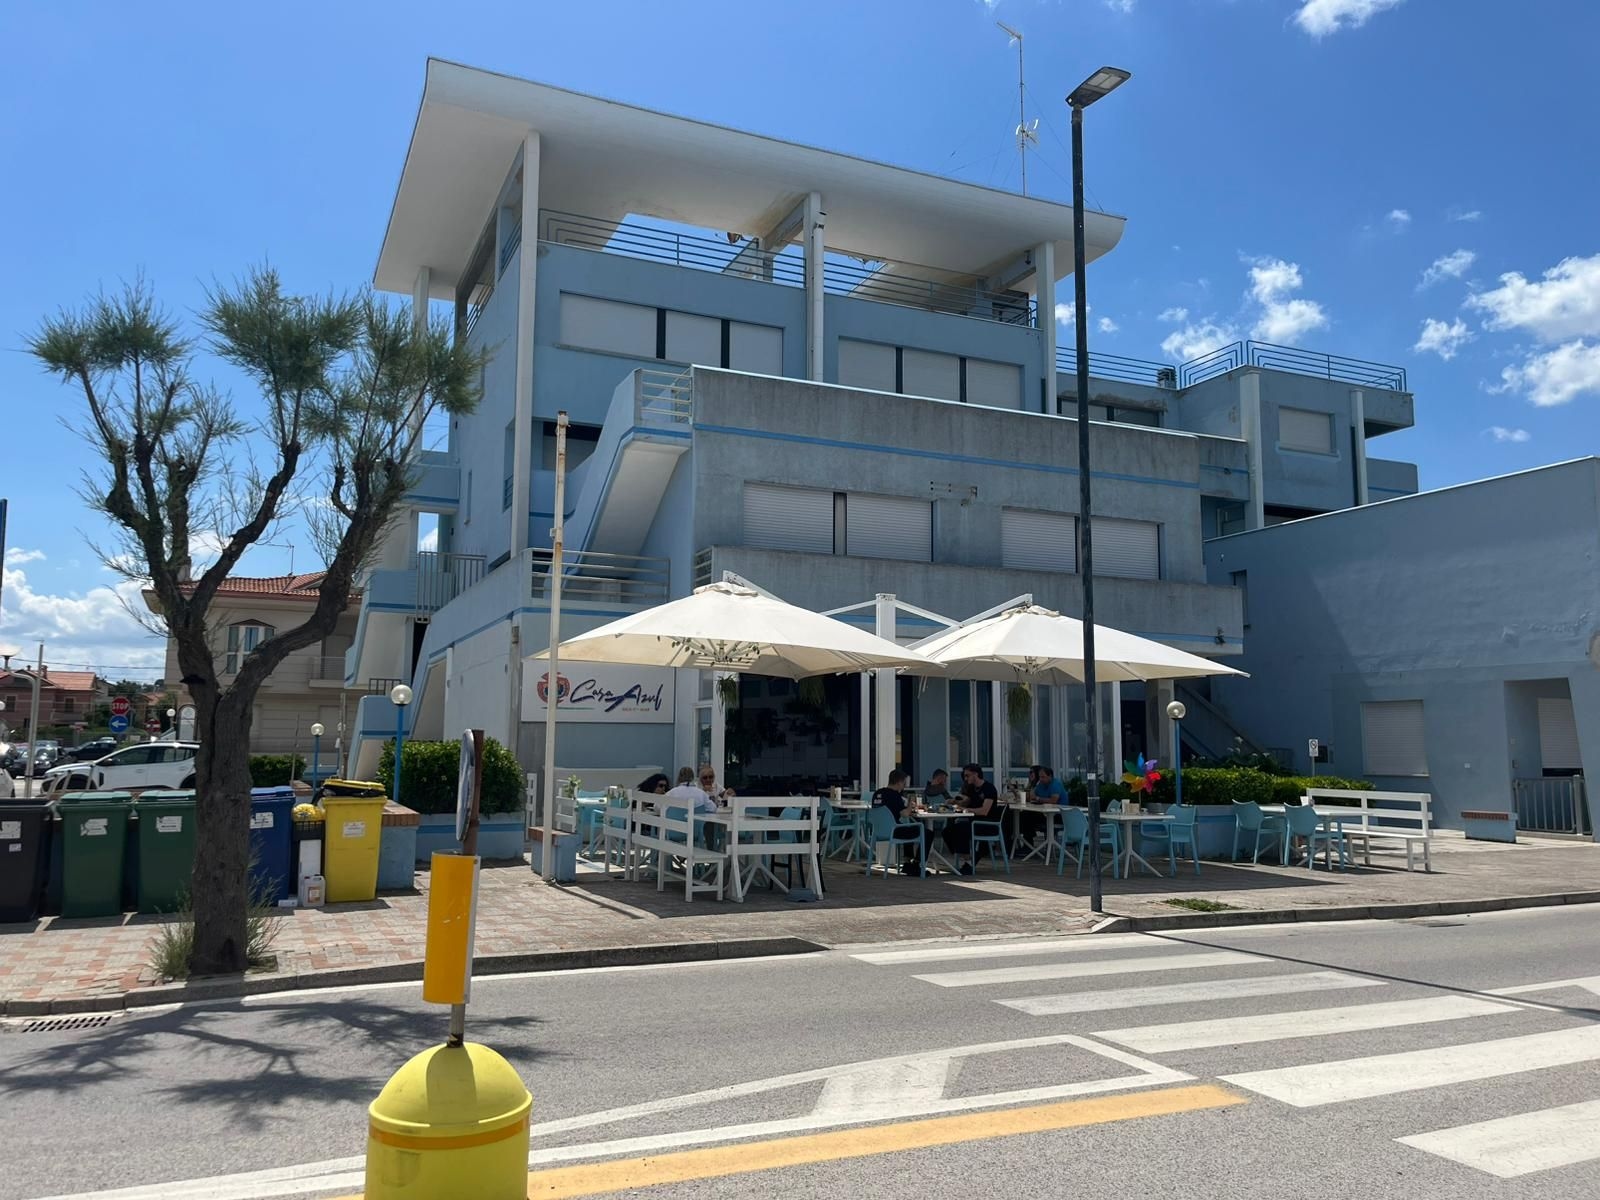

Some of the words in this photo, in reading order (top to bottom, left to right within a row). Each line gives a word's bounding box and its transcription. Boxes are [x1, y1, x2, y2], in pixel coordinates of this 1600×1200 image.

[112, 702, 129, 710] STOP
[569, 679, 614, 704] Casa
[604, 683, 664, 713] Azul
